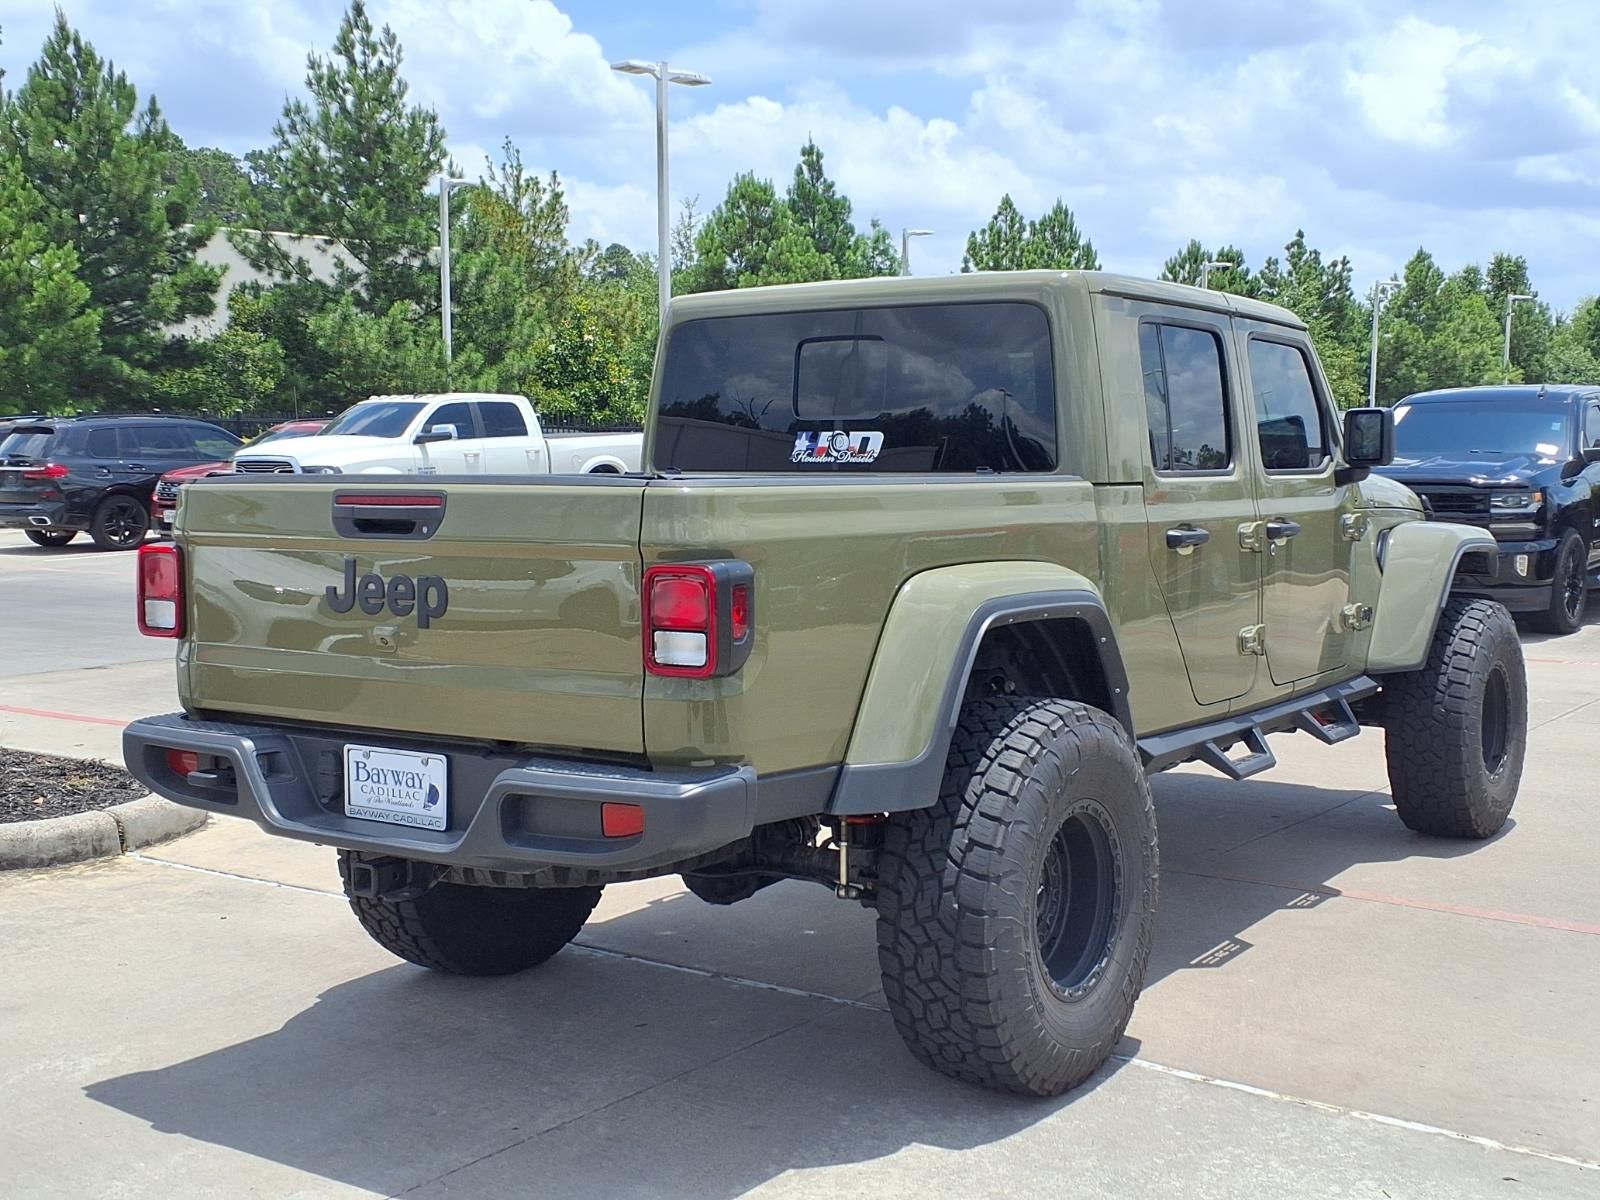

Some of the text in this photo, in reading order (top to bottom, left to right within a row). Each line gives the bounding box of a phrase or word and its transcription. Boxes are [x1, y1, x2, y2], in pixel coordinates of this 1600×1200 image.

[792, 448, 874, 463] Houston Diesels
[325, 553, 449, 629] Jeep
[353, 760, 425, 790] Bayway
[360, 784, 420, 801] CADILLAC
[349, 807, 441, 828] BAYWAY CADILLAC
